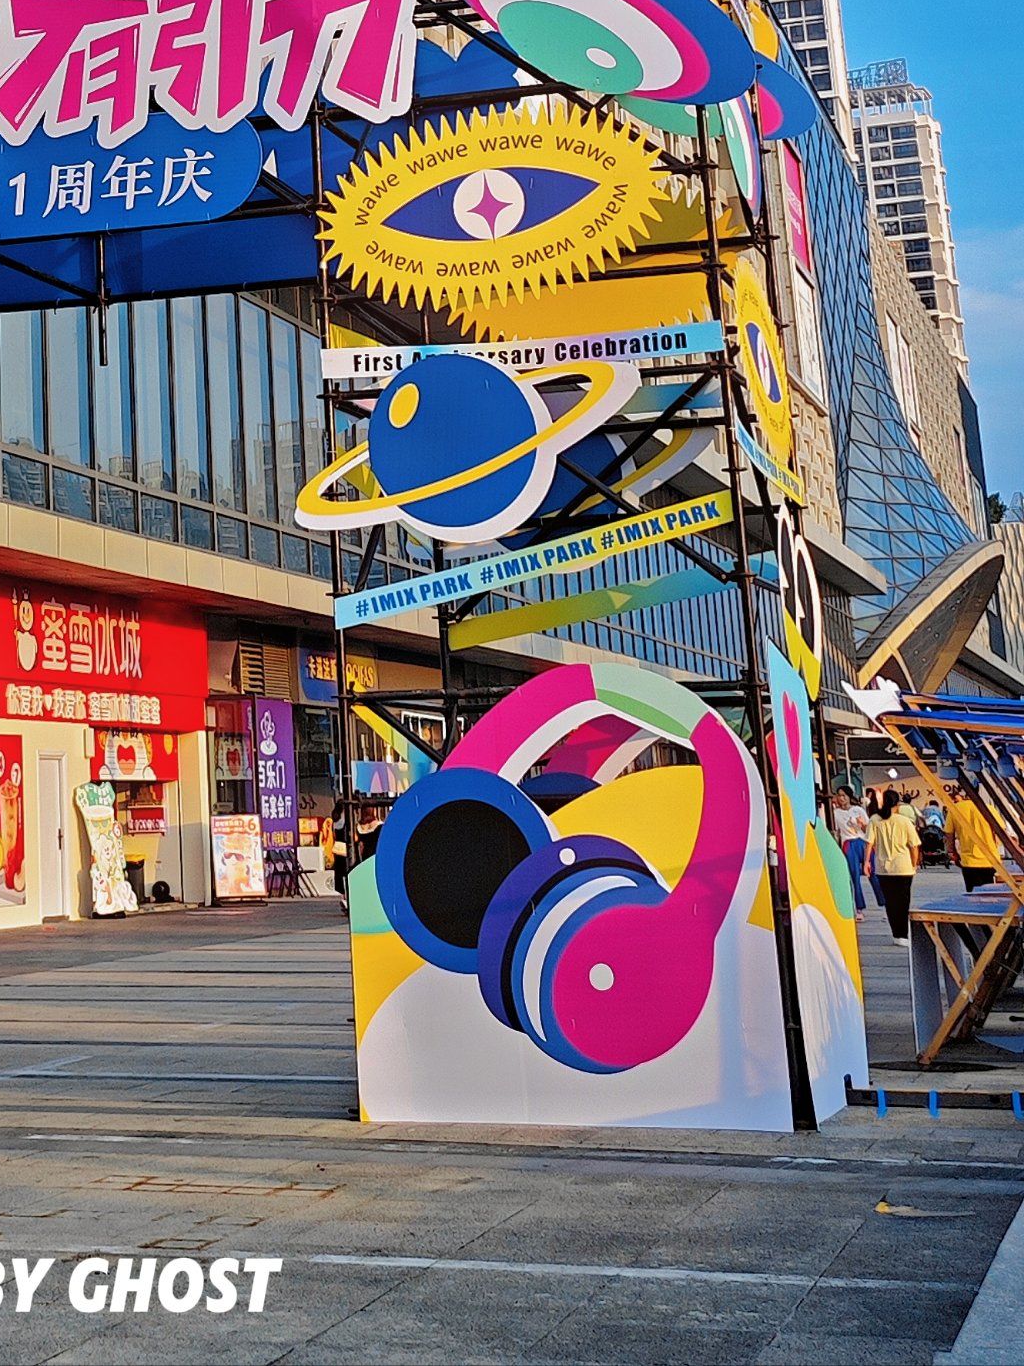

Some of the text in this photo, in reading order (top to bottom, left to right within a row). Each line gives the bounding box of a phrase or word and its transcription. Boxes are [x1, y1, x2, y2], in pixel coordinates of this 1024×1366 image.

[354, 132, 617, 227] wawe wawe wawe wawe
[366, 183, 629, 278] wawe wawe wawe wawe
[353, 353, 404, 373] First
[554, 331, 688, 364] Celebration
[355, 498, 722, 619] #IMIX PARK #IMIX PARK #IMIX PARK
[40, 596, 143, 679] 蜜雪冰城
